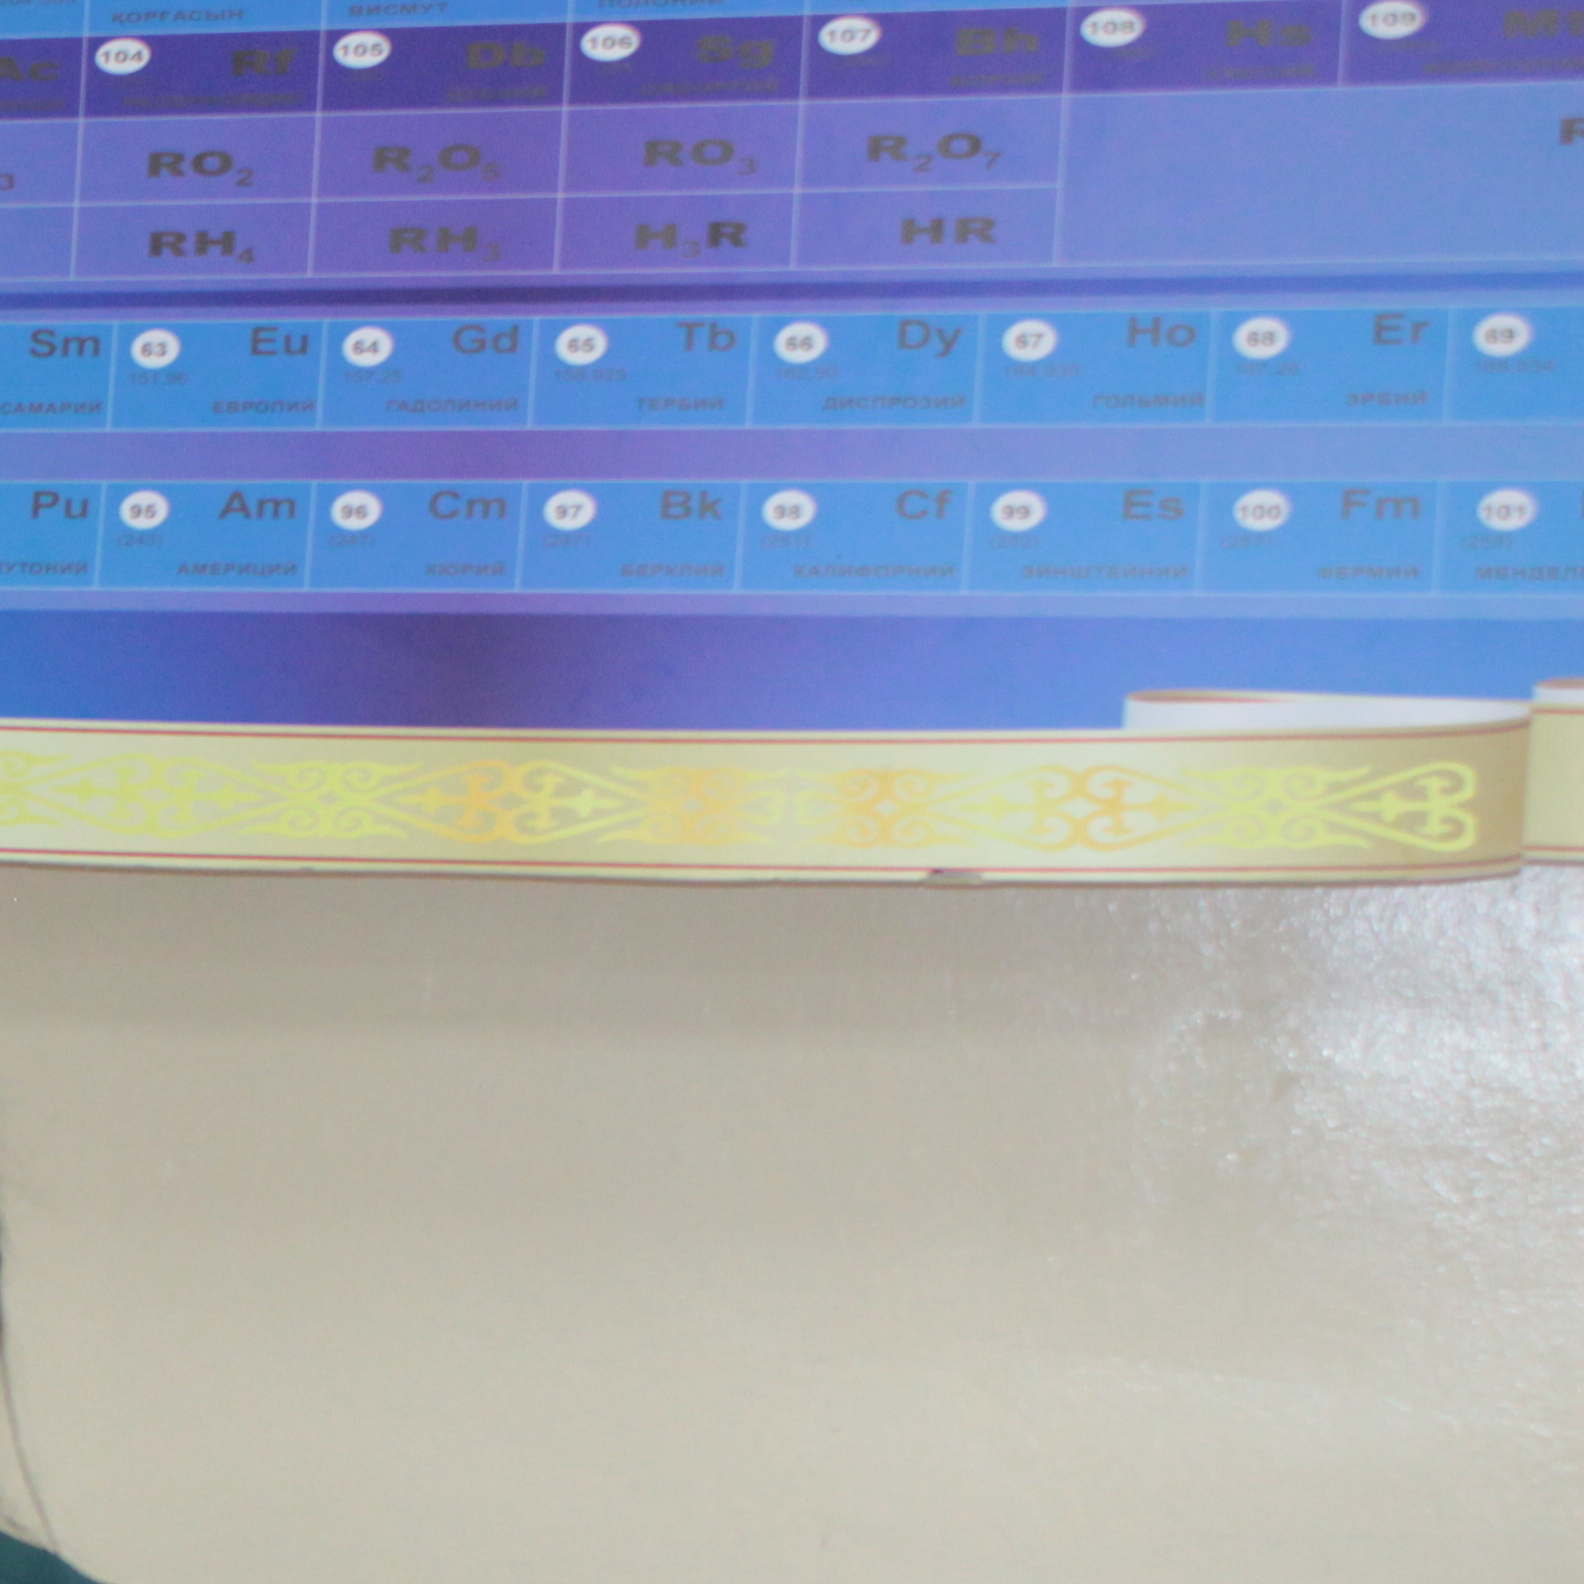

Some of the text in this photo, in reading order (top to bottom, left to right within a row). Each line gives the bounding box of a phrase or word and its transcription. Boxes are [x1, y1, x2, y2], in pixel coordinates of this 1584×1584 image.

[349, 2, 448, 16] ВИСМУТ
[100, 50, 144, 65] 104
[900, 217, 996, 245] HR
[29, 328, 101, 358] Sm
[250, 326, 309, 356] Eu
[453, 325, 519, 354] Gd
[677, 322, 736, 352] Tb
[898, 319, 963, 357] Dy
[1127, 317, 1196, 348] Ho
[1373, 312, 1430, 345] Er
[142, 343, 166, 357] 63
[0, 401, 102, 415] САМАРИЙ
[214, 400, 315, 414] ЕВРОПИЙ
[32, 490, 90, 519] Pu
[219, 490, 297, 519] Am
[429, 490, 507, 519] Cm
[555, 505, 580, 520] 97
[660, 490, 722, 520] Bk
[895, 490, 953, 520] Cf
[1122, 489, 1185, 521] Es
[1340, 488, 1421, 520] Fm
